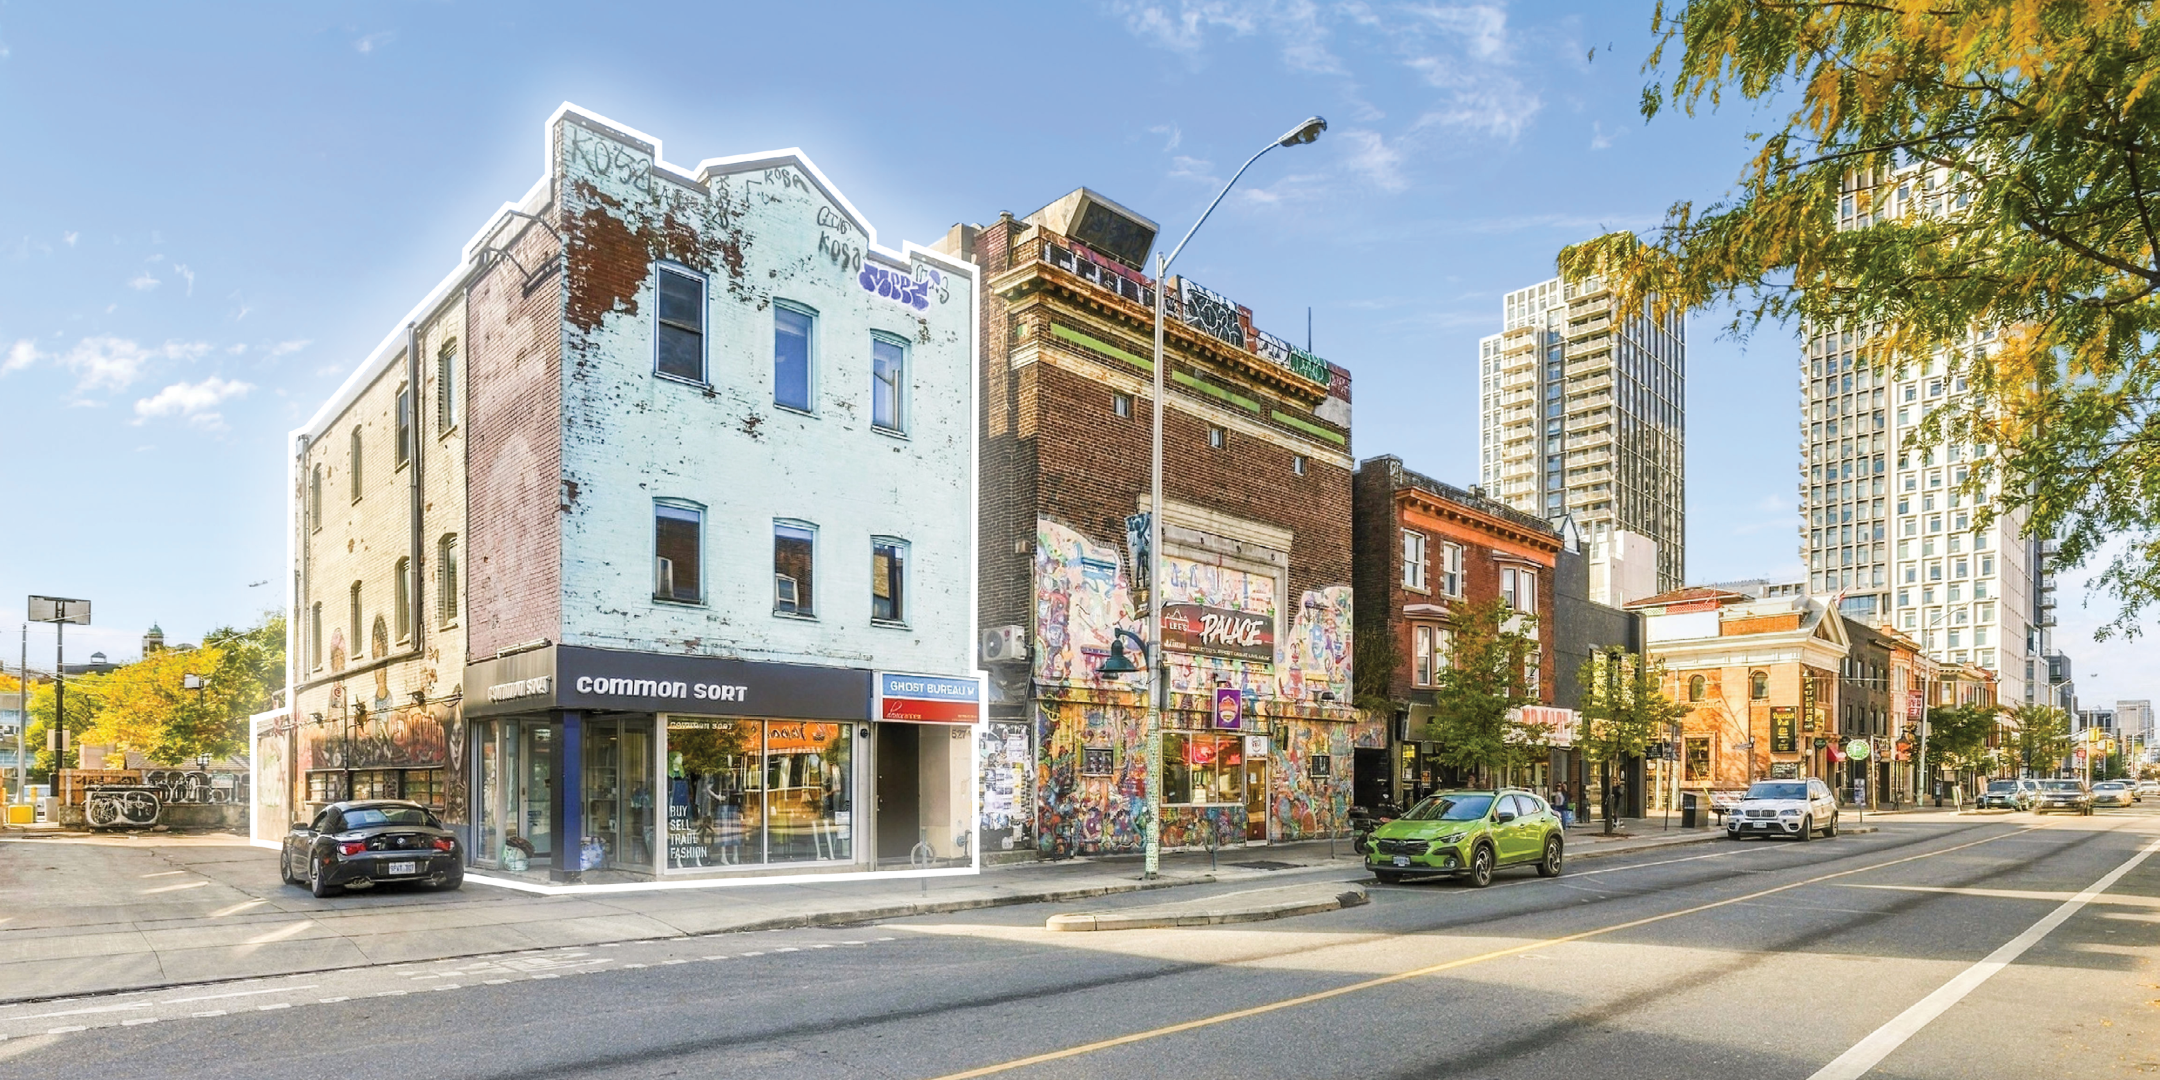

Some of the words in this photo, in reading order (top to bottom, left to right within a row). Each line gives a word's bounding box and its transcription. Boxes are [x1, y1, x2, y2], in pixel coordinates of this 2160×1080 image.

[1199, 613, 1264, 647] PALACE
[890, 681, 924, 693] GHOST
[927, 684, 965, 695] BUREAU
[669, 805, 688, 817] BUY
[669, 819, 691, 831] SELL
[670, 833, 698, 845] TRADE
[670, 846, 708, 859] FASHION
